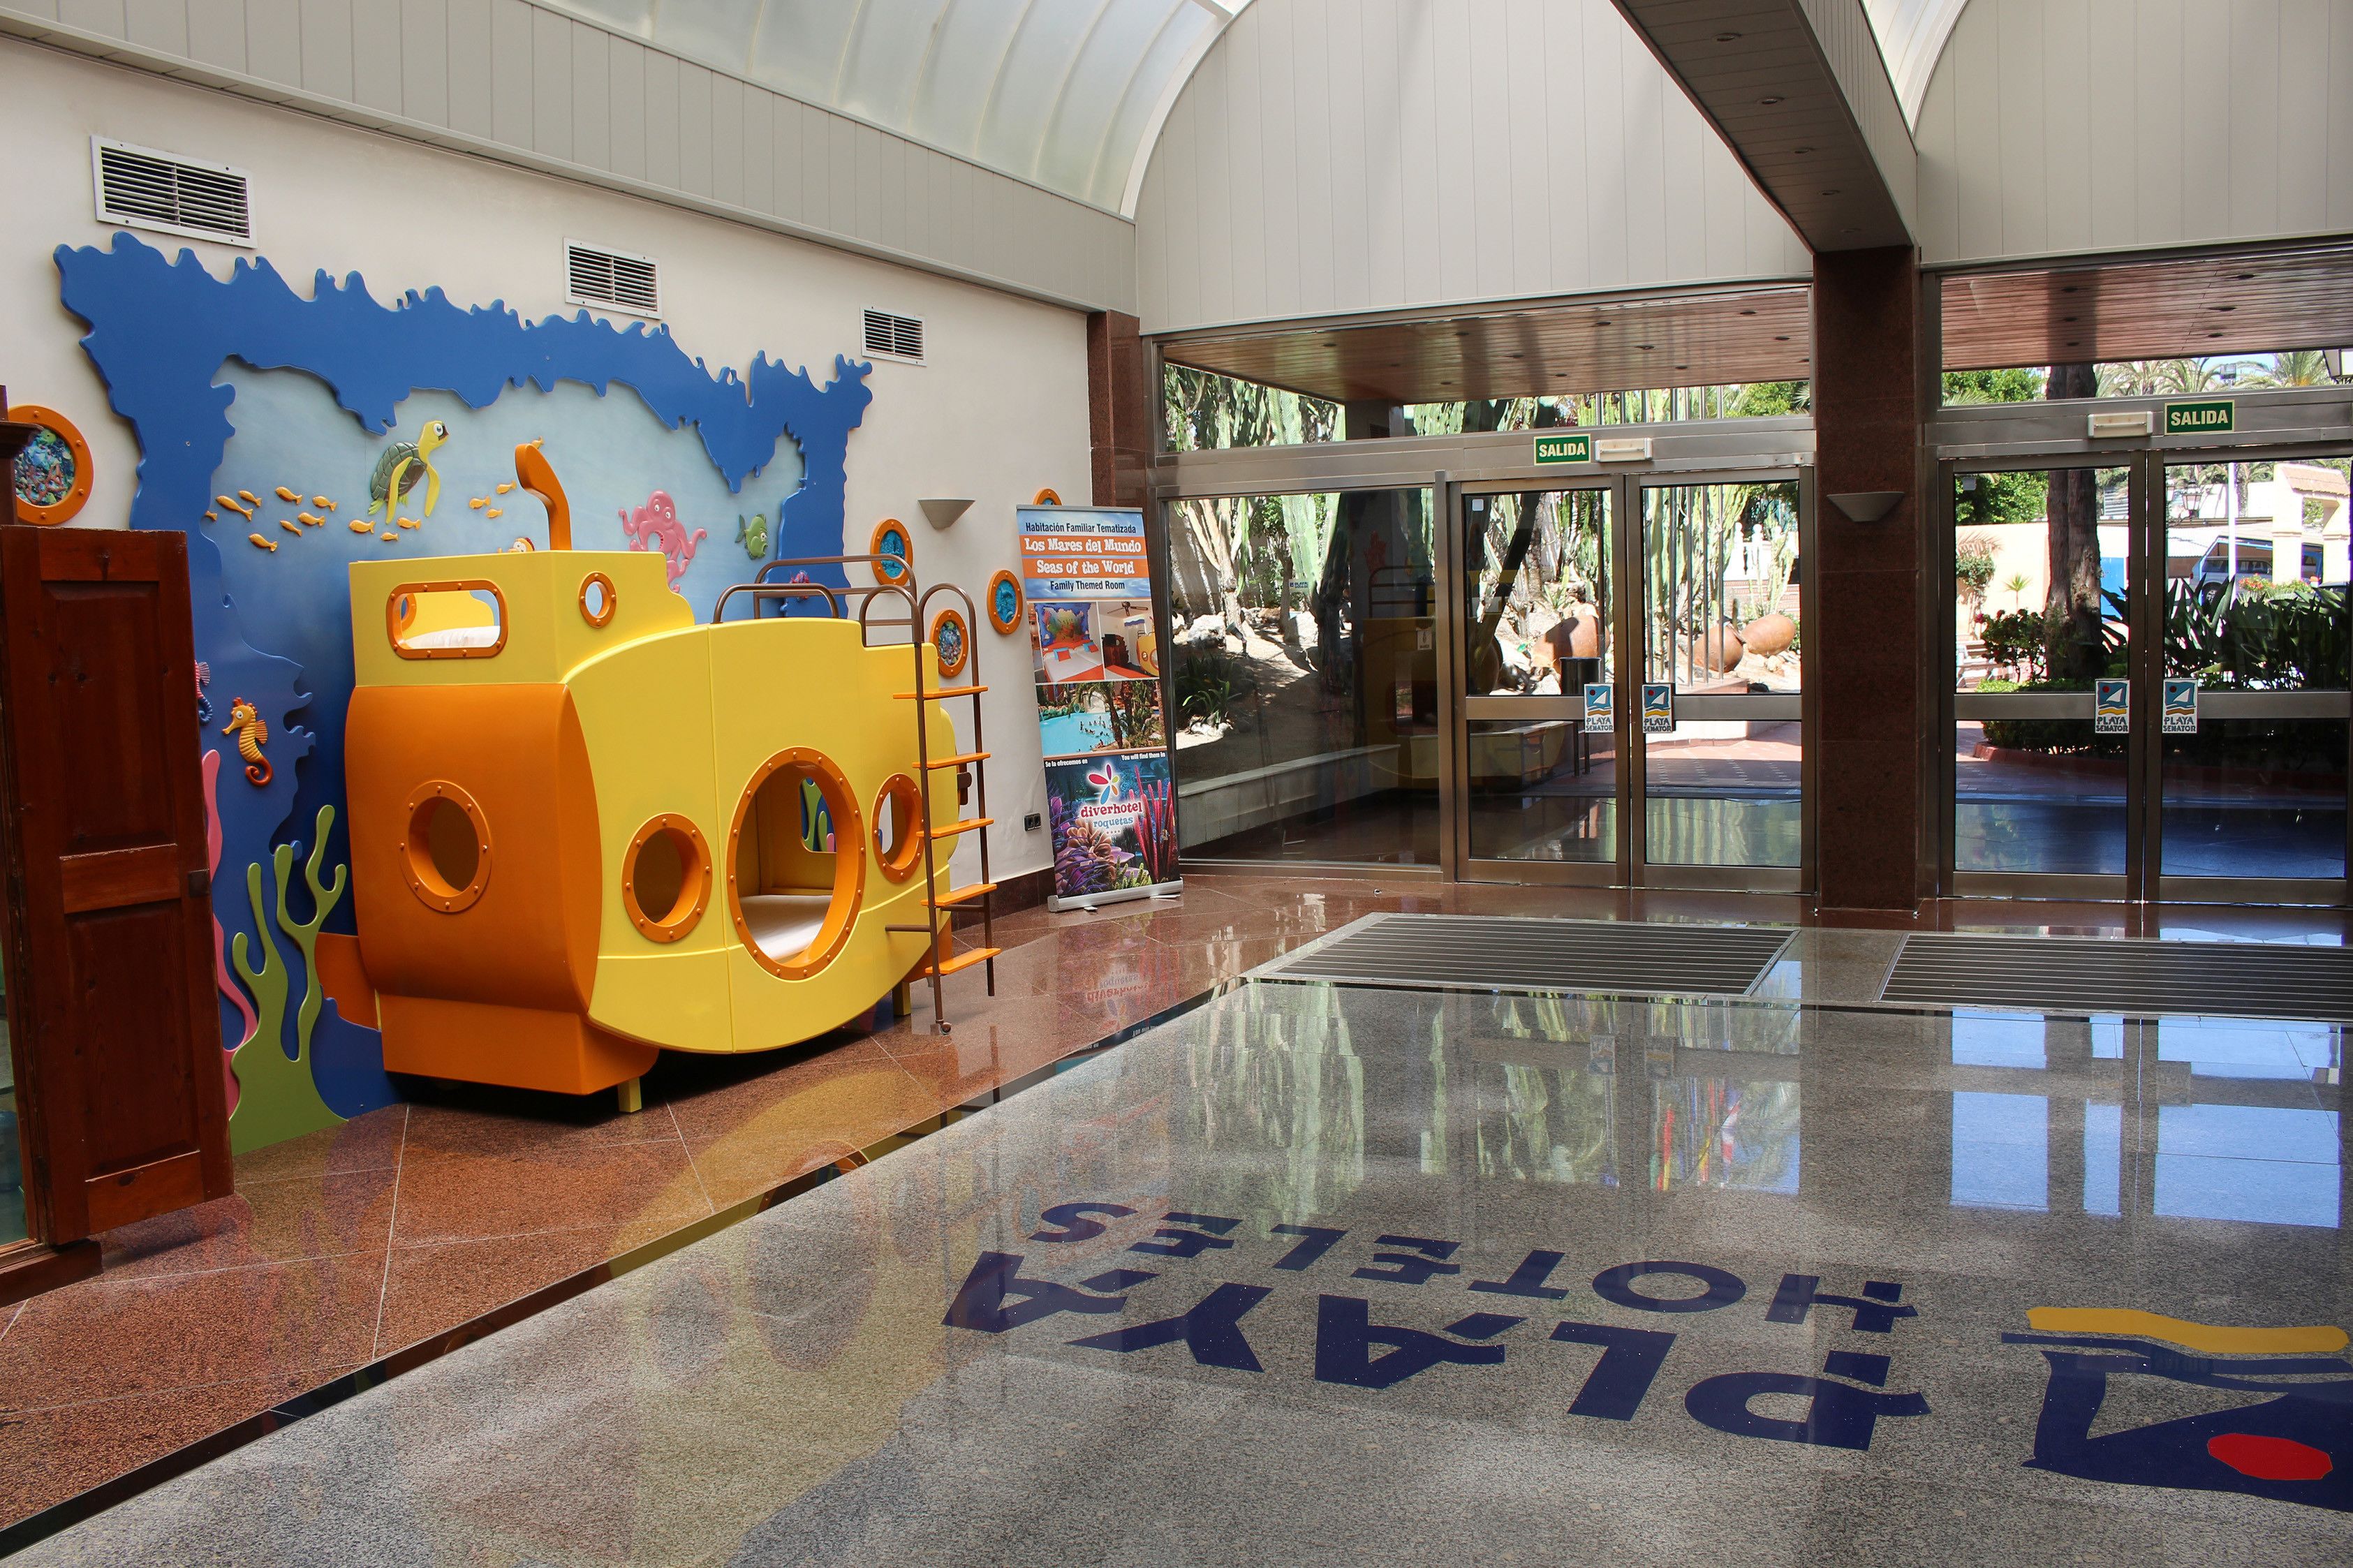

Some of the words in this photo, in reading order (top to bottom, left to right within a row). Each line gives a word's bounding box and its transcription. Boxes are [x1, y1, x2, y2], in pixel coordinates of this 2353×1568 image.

[2171, 410, 2228, 427] SALIDA
[1539, 442, 1586, 458] SALIDA
[1026, 522, 1064, 532] Habitación
[1066, 523, 1095, 533] Familiar
[1097, 524, 1136, 533] Tematizada
[1024, 538, 1045, 552] Los
[1047, 538, 1083, 552] Mares
[1086, 539, 1102, 553] del
[1104, 538, 1142, 553] Mundo
[1036, 559, 1063, 574] Seas
[1066, 561, 1078, 575] of
[1082, 561, 1099, 575] the
[1102, 560, 1135, 575] World
[1050, 580, 1074, 592] Family
[1076, 580, 1103, 590] Themed
[1105, 580, 1125, 589] Room
[1586, 717, 1611, 725] PLAYA
[1644, 718, 1669, 726] PLAYA
[2097, 716, 2126, 725] PLAYA
[2164, 716, 2194, 725] PLAYA
[1081, 802, 1142, 818] diverhotel
[1093, 817, 1133, 829] roquetas
[1028, 1202, 1919, 1333] HOTELES
[941, 1250, 1932, 1451] PLAYA
